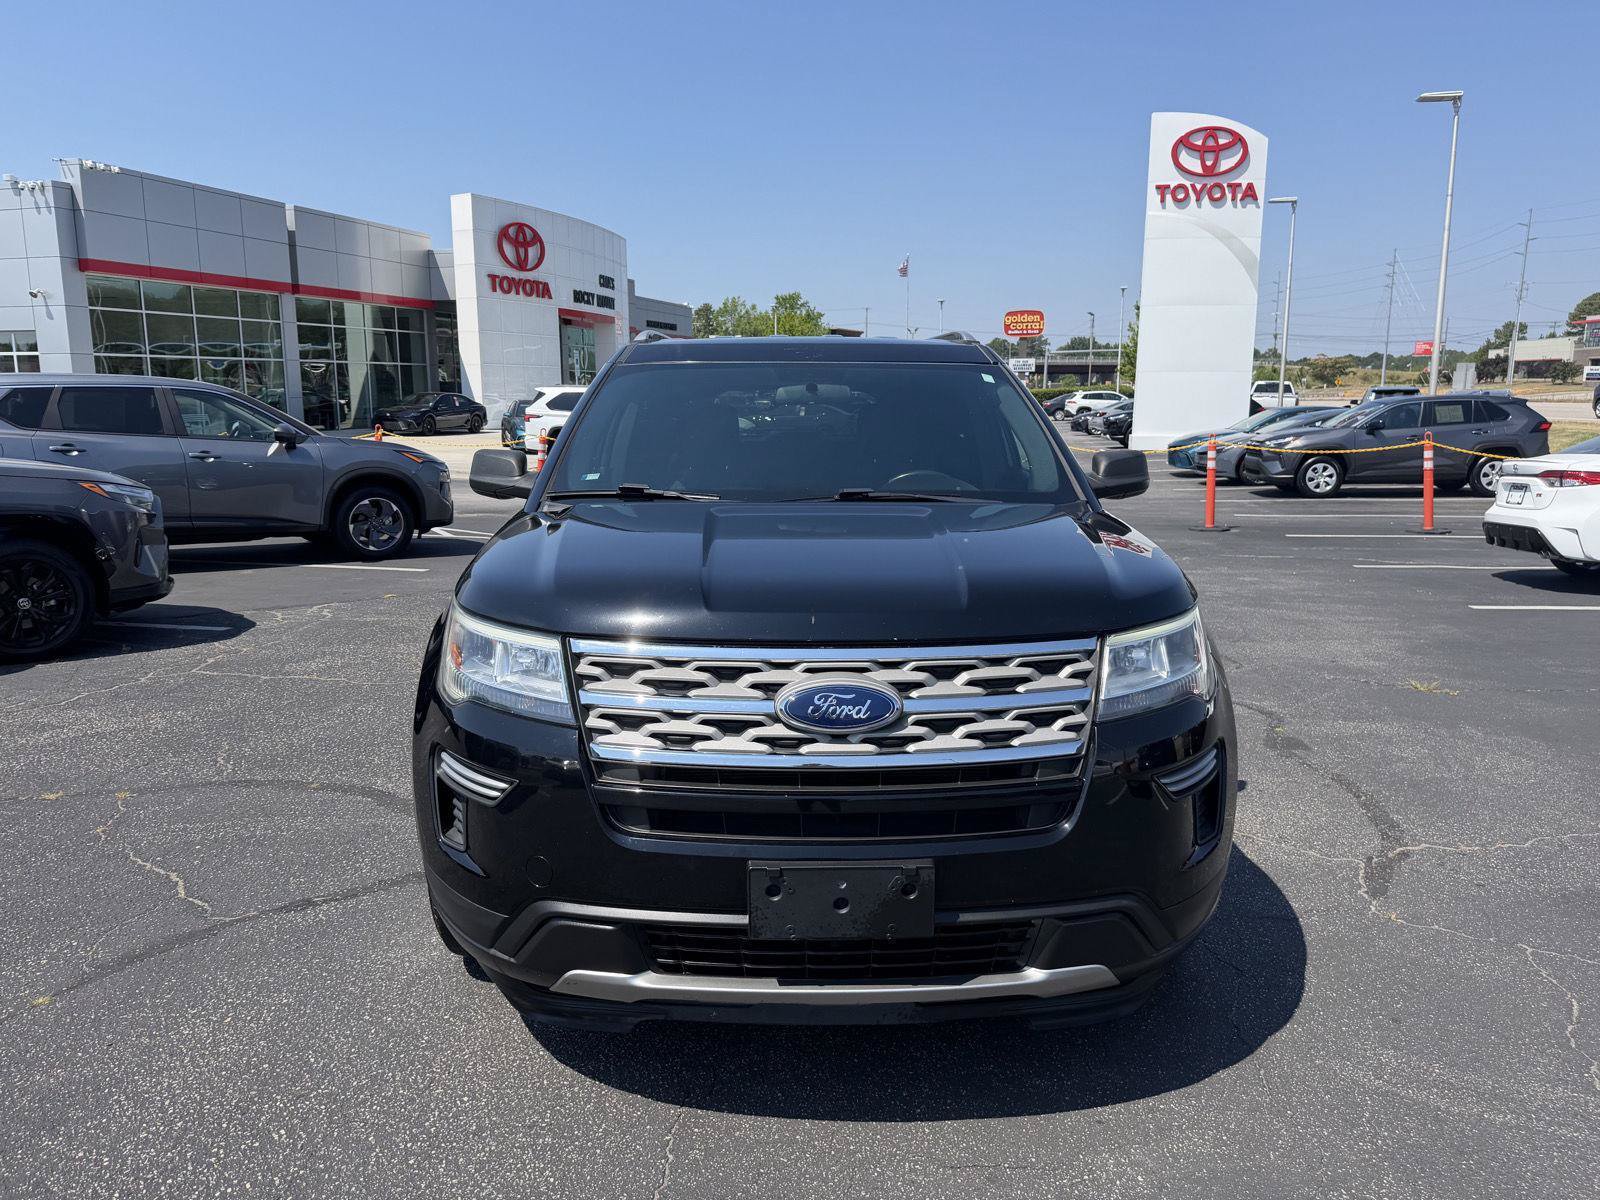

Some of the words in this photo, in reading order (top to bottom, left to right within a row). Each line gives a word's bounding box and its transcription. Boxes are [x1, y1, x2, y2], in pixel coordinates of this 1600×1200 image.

[1155, 182, 1258, 204] TOYOTA
[487, 273, 553, 299] TOYOTA
[573, 289, 595, 306] ROCKY
[1005, 313, 1040, 325] golden
[1010, 320, 1043, 330] corral
[807, 692, 871, 719] Ford
